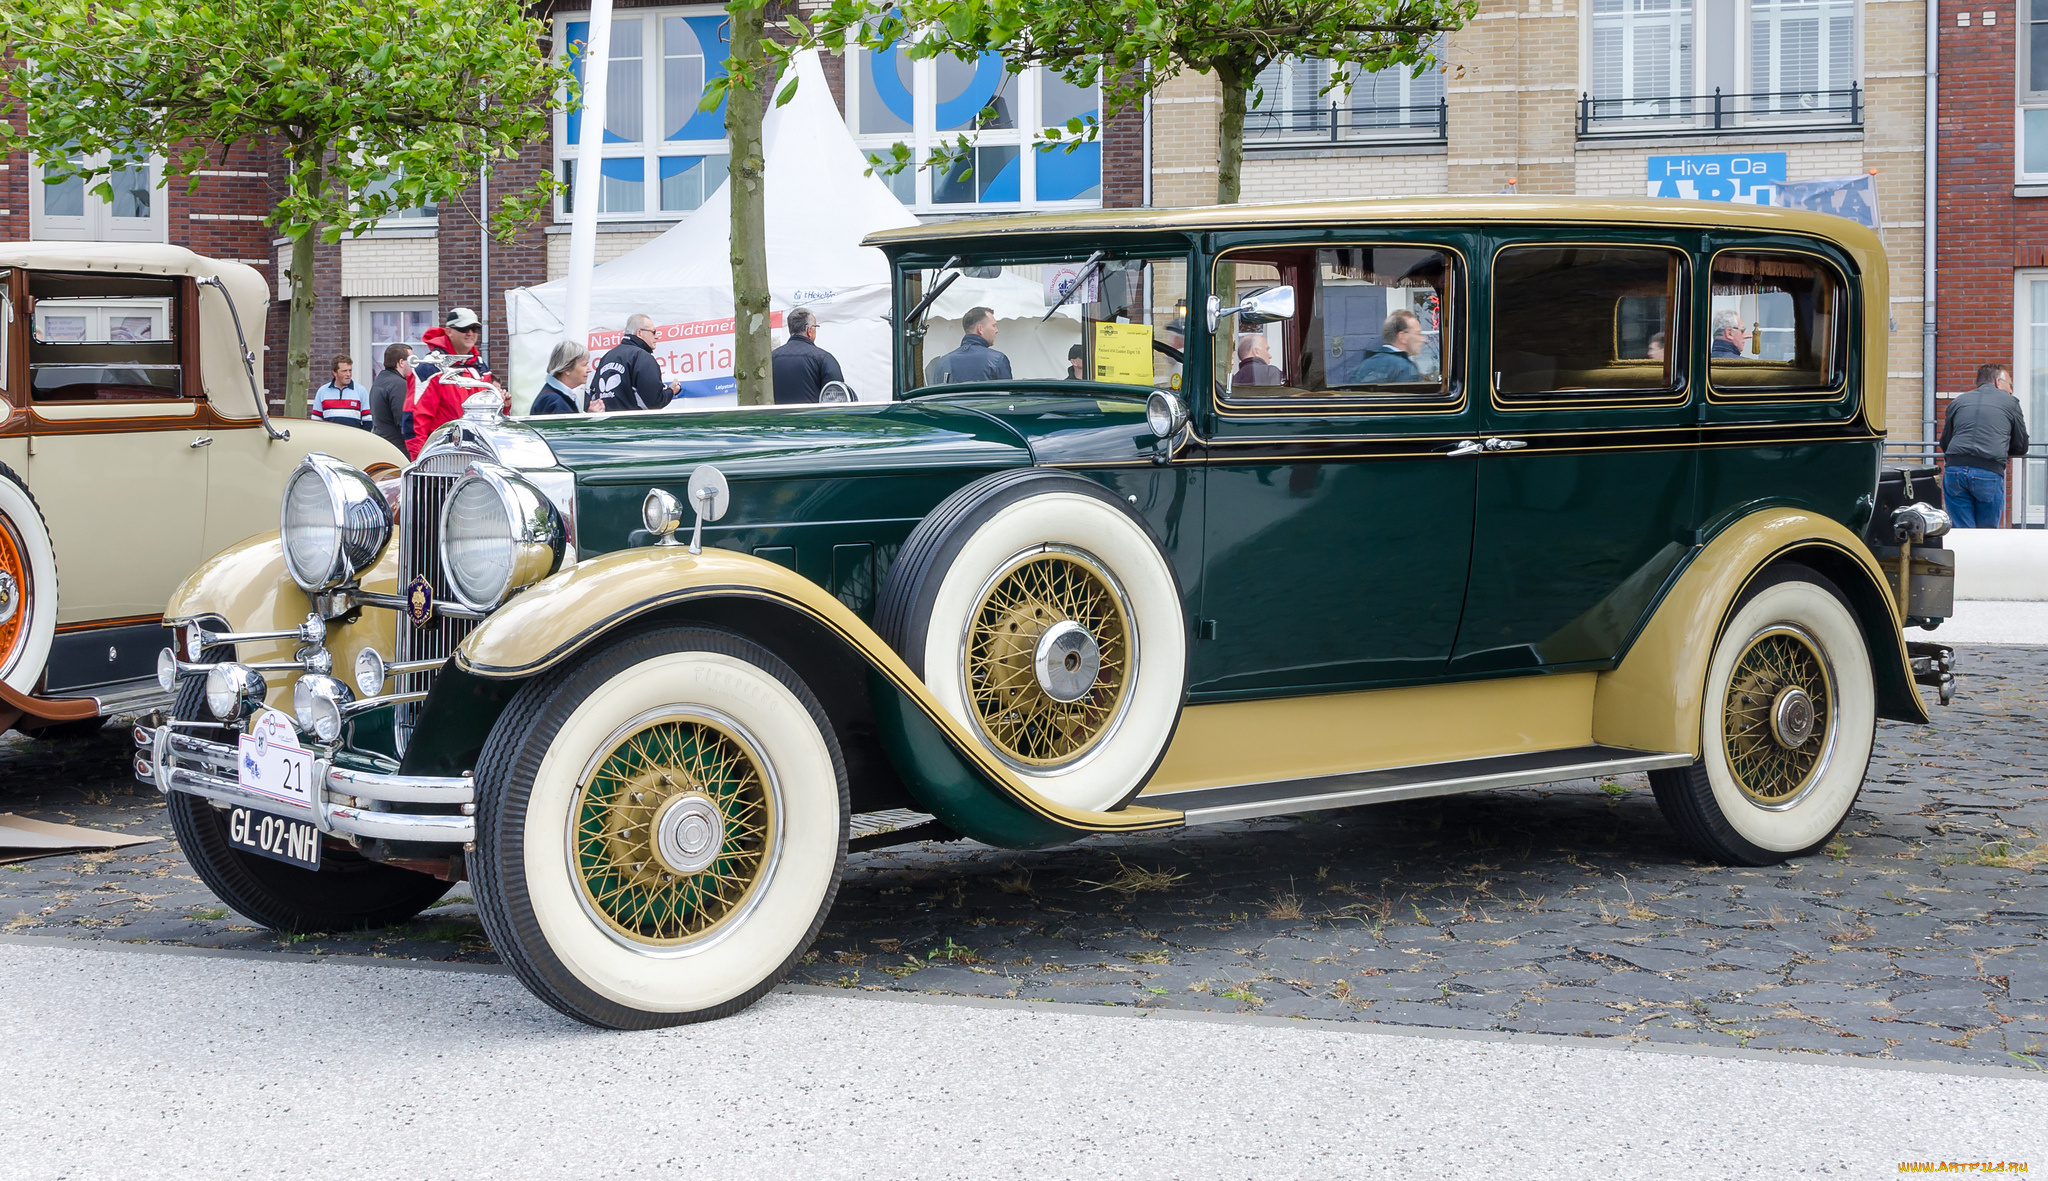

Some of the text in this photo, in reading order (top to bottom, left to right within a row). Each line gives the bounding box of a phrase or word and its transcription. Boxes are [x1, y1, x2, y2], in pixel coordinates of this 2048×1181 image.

[1666, 158, 1767, 176] Hiva Oa
[667, 321, 736, 338] Oldtimer
[282, 758, 304, 794] 21
[230, 808, 319, 864] GL-02-NH
